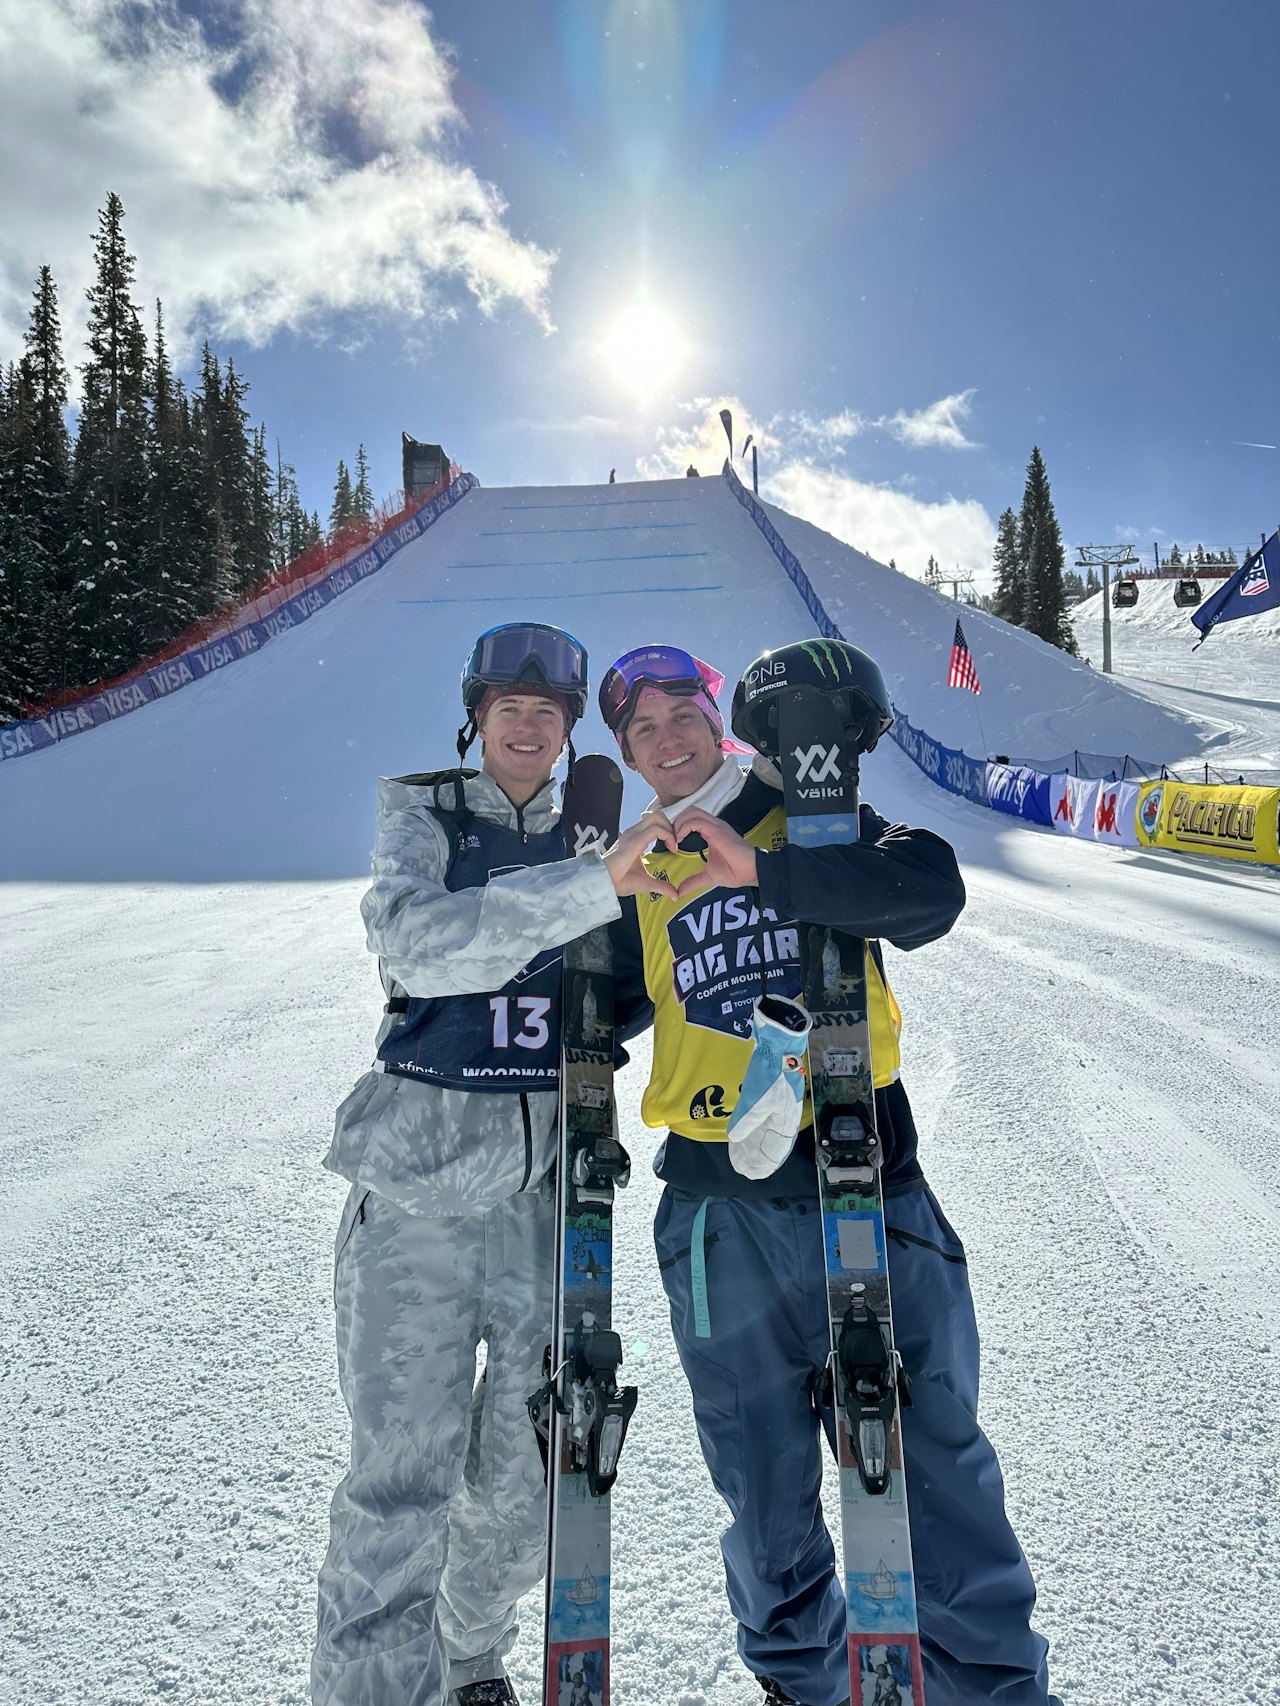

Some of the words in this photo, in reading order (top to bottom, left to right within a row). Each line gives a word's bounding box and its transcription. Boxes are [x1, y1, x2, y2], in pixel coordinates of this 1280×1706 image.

[395, 519, 420, 544] VISA
[356, 553, 379, 578] VISA
[328, 568, 353, 595] VISA
[295, 590, 325, 617] VISA
[262, 612, 293, 637] VISA
[195, 641, 234, 672] VISA
[149, 662, 193, 694] VISA
[756, 680, 788, 694] MARKER
[100, 683, 148, 718] VISA
[38, 706, 94, 740] VISA
[1167, 791, 1257, 841] PACIFICO
[678, 895, 778, 943] VISA
[676, 944, 728, 994] BIG
[736, 928, 800, 968] AIR
[697, 980, 730, 1000] COPPER
[733, 996, 758, 1008] TOYOT
[489, 996, 551, 1050] 13
